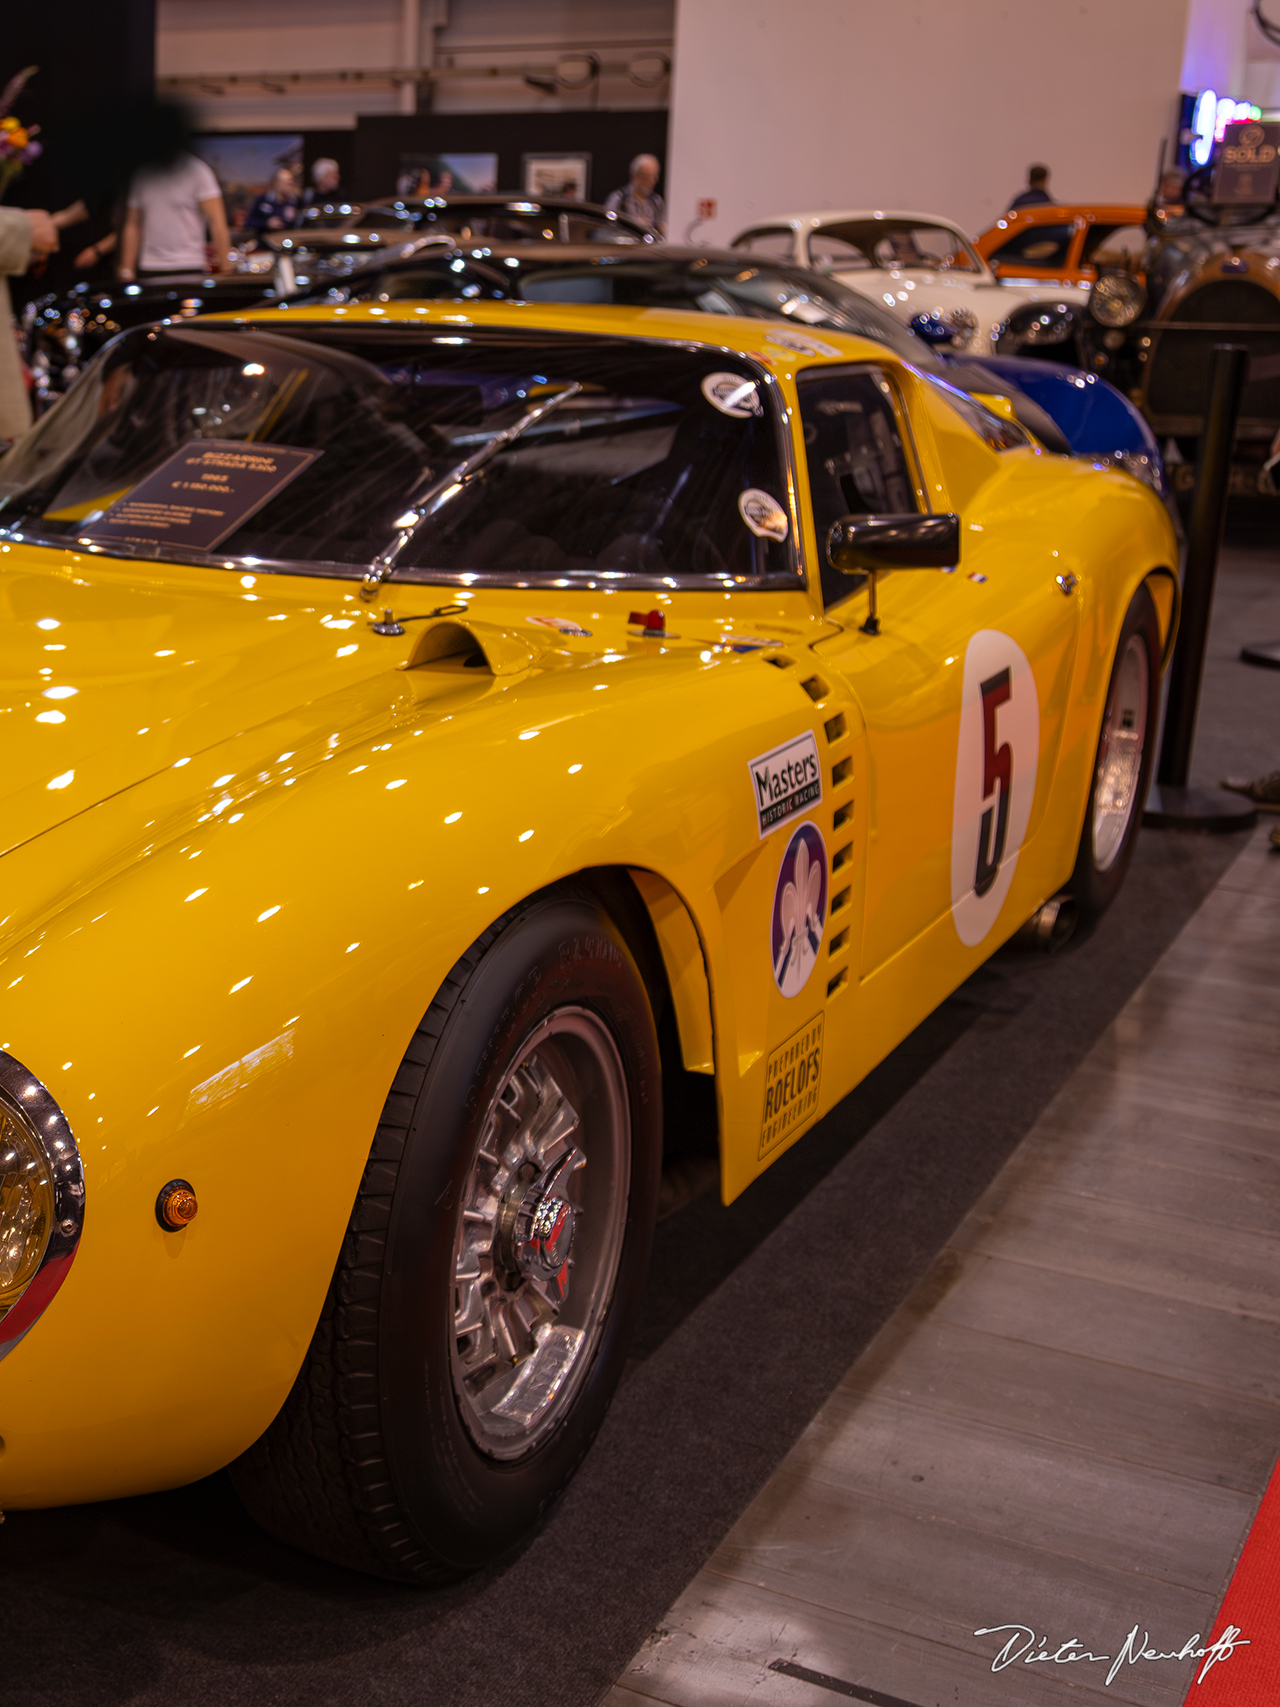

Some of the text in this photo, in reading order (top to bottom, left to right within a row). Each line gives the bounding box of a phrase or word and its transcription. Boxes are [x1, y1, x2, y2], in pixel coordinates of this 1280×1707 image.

[1222, 144, 1277, 163] SOLD
[755, 754, 818, 807] Masters
[761, 783, 821, 826] HISTORIC RACING
[973, 665, 1012, 898] 5
[767, 1022, 823, 1084] PREPARED BY
[764, 1047, 820, 1124] ROELOFS
[761, 1086, 818, 1149] ENGINEERING
